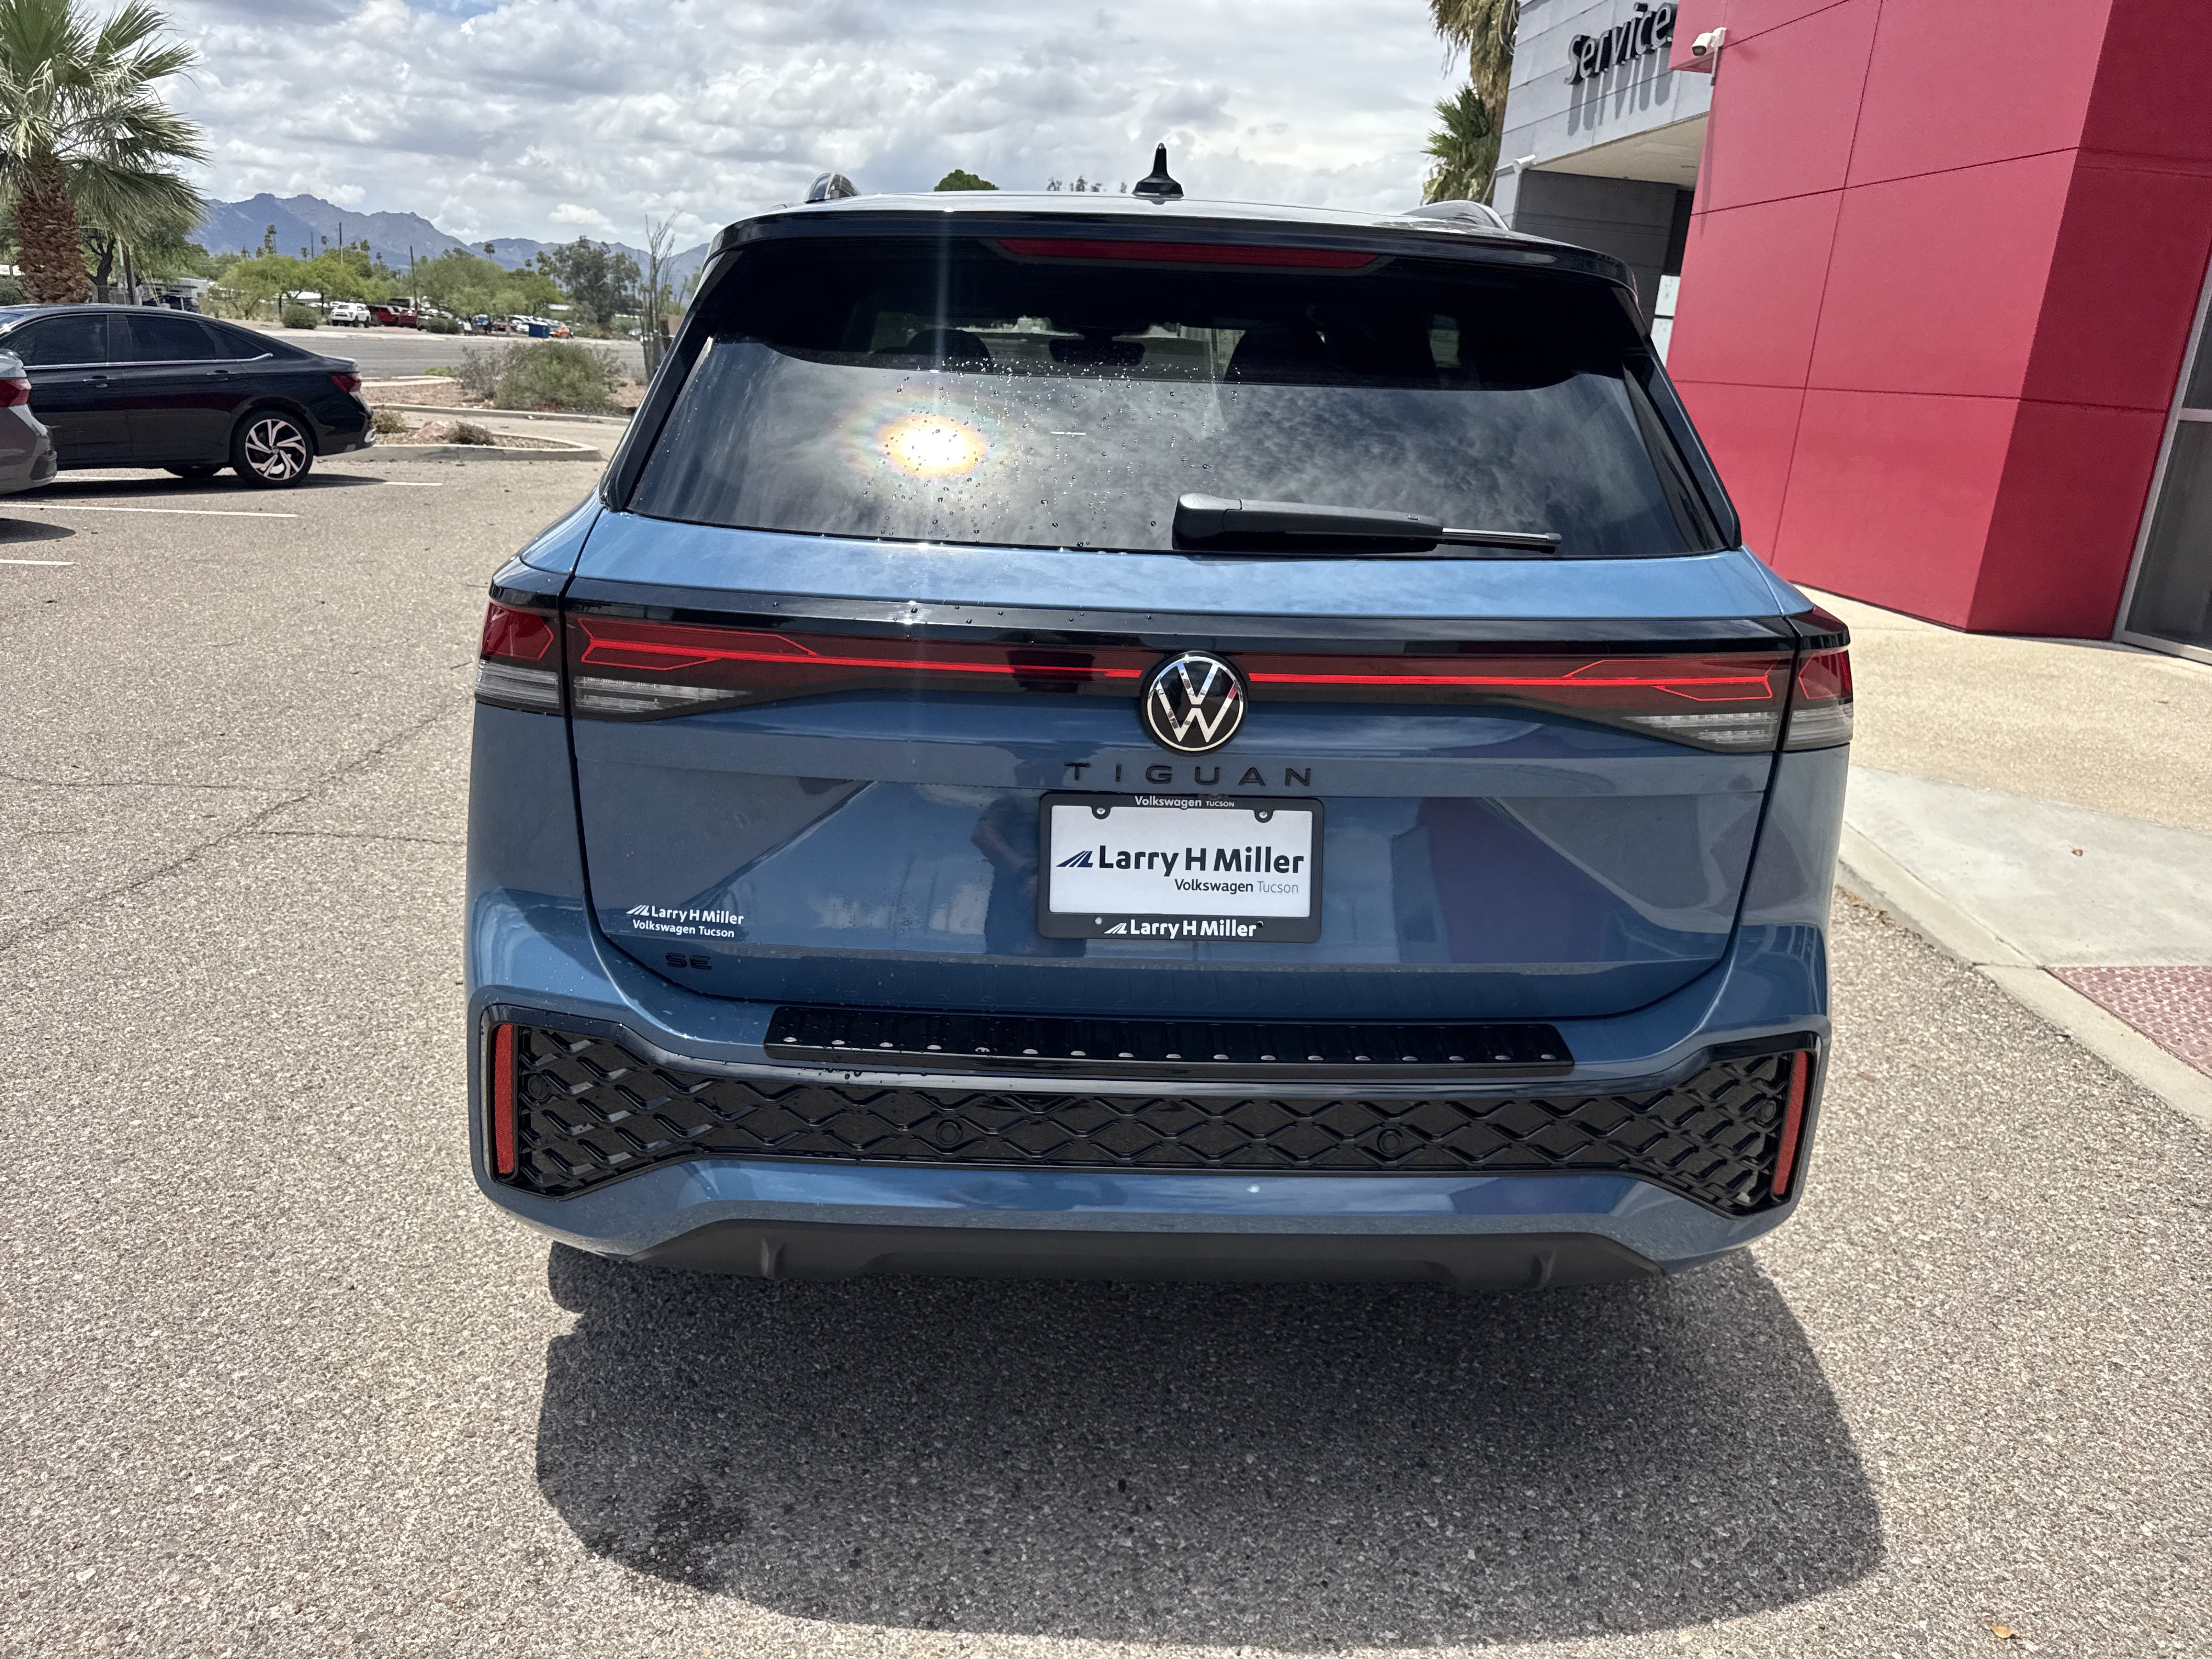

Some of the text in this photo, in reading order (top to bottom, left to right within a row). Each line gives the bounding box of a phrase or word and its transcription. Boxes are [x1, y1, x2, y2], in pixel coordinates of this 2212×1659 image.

[1564, 2, 1673, 85] Service
[1063, 761, 1311, 787] TIGUAN
[1135, 795, 1202, 810] Volkswagen
[1099, 845, 1304, 877] Larry H Miller
[1174, 878, 1299, 895] Volkswagen Tucson
[651, 905, 744, 925] Larry H Miller
[633, 919, 735, 938] Volkswagen Tucson
[1130, 919, 1257, 939] Larry H Miller
[665, 952, 712, 970] SE
